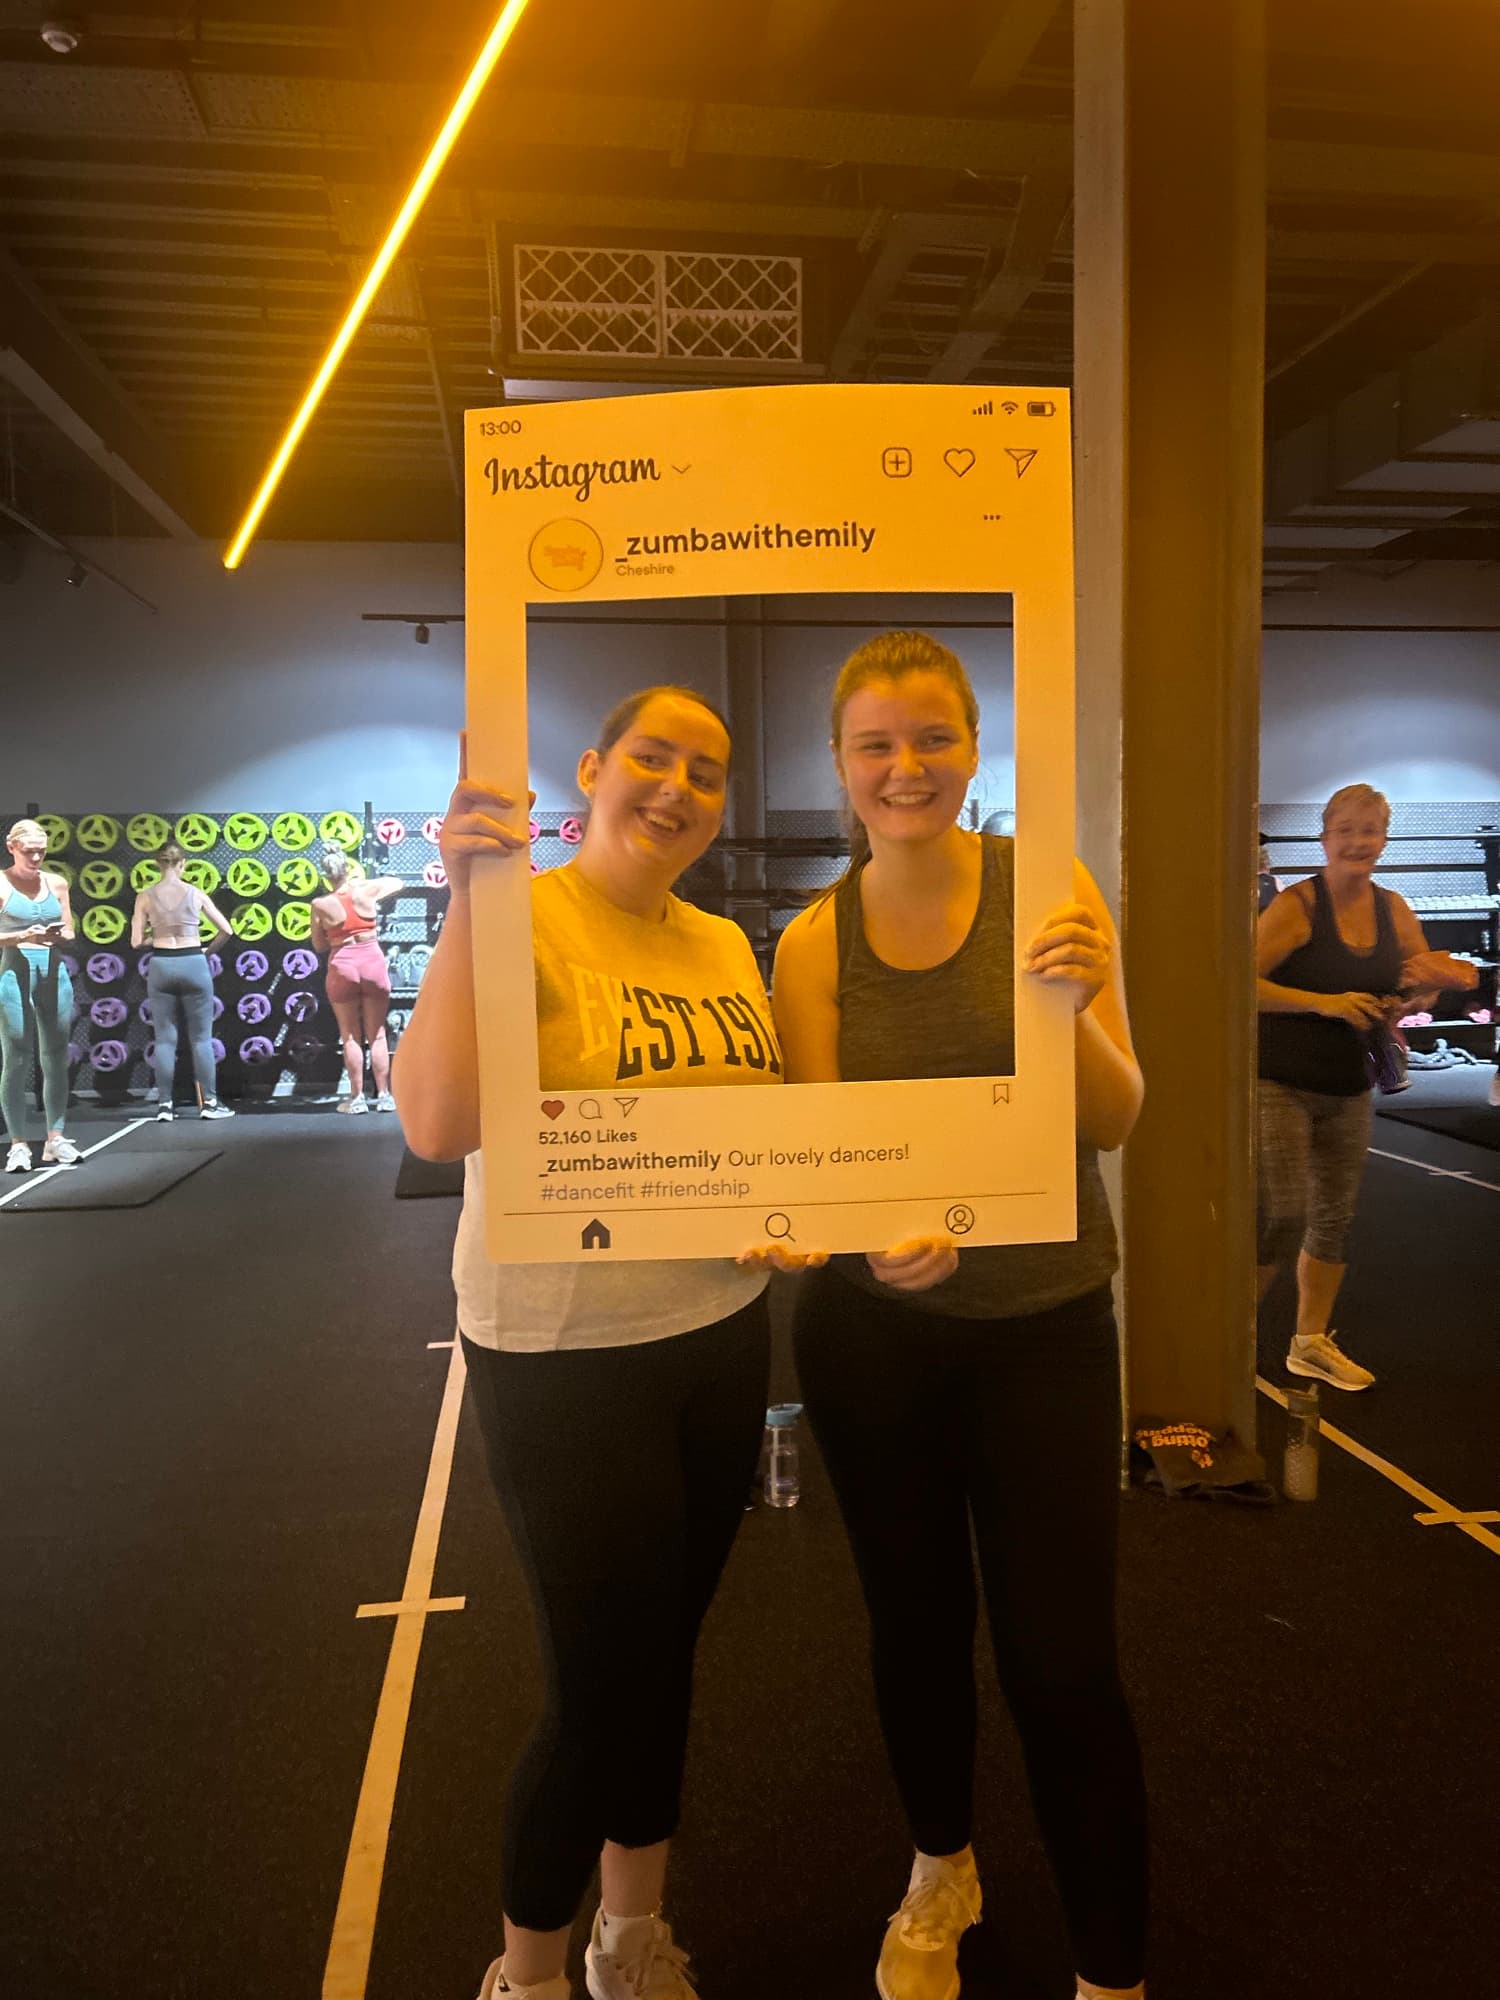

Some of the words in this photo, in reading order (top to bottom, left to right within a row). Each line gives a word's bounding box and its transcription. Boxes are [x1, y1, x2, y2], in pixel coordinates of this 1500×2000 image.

[479, 419, 522, 437] 13:00
[484, 454, 661, 503] Instagram
[615, 520, 876, 562] _zumbawithemily
[615, 562, 675, 577] Cheshire
[616, 981, 706, 1081] EST
[700, 991, 784, 1075] 191
[596, 1128, 638, 1144] Likes
[538, 1150, 721, 1177] _zumbawithemily
[727, 1149, 765, 1168] Our
[769, 1147, 825, 1168] lovely
[829, 1143, 910, 1164] dancers!
[541, 1181, 635, 1201] #dancefit
[640, 1178, 750, 1200] #friendship
